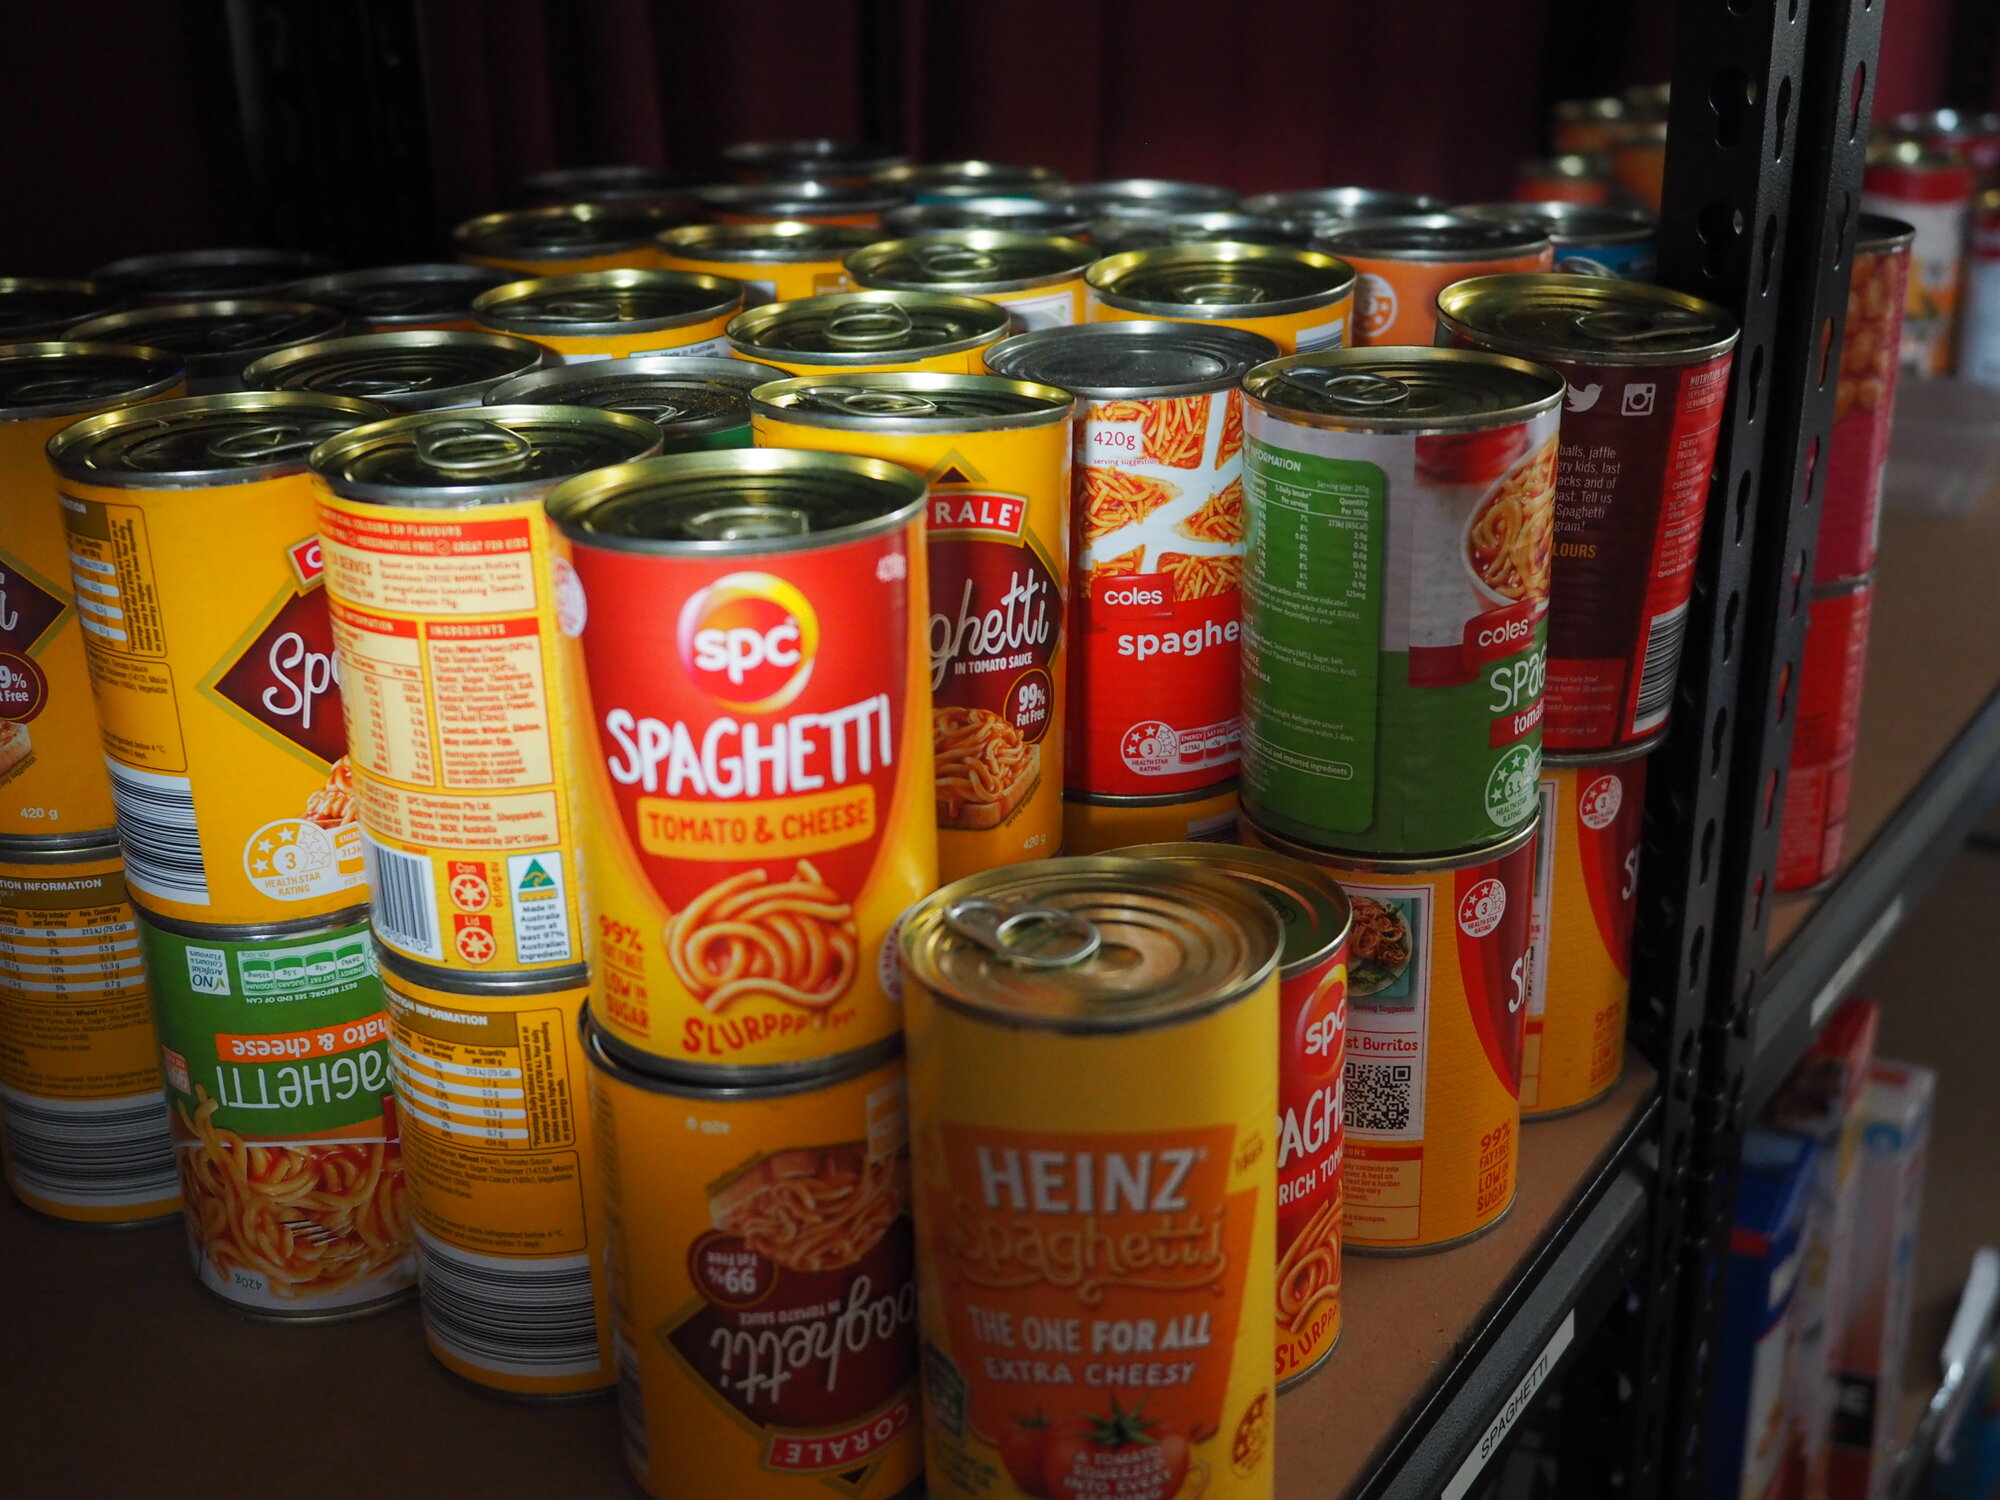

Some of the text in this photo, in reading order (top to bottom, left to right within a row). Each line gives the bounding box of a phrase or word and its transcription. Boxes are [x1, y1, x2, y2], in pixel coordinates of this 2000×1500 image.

[1093, 431, 1136, 450] 420g
[1589, 447, 1616, 460] jaffle
[1575, 461, 1598, 474] kids,
[1602, 463, 1621, 474] last
[1584, 477, 1603, 488] and
[1606, 477, 1617, 488] of
[1581, 490, 1597, 503] Tell
[1600, 494, 1612, 503] us
[1556, 504, 1605, 520] Spaghetti
[1104, 586, 1163, 605] coles
[429, 623, 506, 637] INGREDIENTS
[1478, 618, 1529, 647] coles
[1117, 619, 1241, 661] spaghe
[693, 626, 801, 686] spc
[955, 652, 1033, 675] IN TOMATO SAUCE
[1018, 683, 1046, 712] 99%
[1016, 708, 1046, 728] Fat Free
[606, 693, 893, 799] SPAGHETTI
[1146, 743, 1154, 755] 3
[1132, 758, 1169, 767] HEALTH STAR
[1139, 764, 1162, 773] RATING
[20, 807, 59, 821] 420 g
[647, 798, 869, 845] TOMATO & CHEESE
[284, 851, 298, 870] 3
[456, 862, 477, 874] Can
[24, 879, 103, 891] INFORMATION
[264, 872, 322, 889] HEALTH STAR
[278, 884, 311, 897] RATING
[522, 903, 556, 913] Made in
[1481, 902, 1488, 915] 3
[464, 916, 480, 927] Lid
[520, 913, 560, 923] Australia
[1467, 914, 1498, 930] HEALTH STAR
[525, 922, 557, 932] from at
[1474, 924, 1492, 935] RATING
[520, 933, 541, 941] least
[521, 941, 565, 950] Australian
[189, 950, 222, 961] Flavours
[519, 949, 568, 961] ingredients
[192, 965, 224, 976] Artificial
[195, 958, 223, 969] Colours
[192, 974, 213, 988] NO
[278, 979, 305, 988] SUGARS
[323, 973, 336, 982] SAT
[308, 985, 339, 998] BEFORE:
[341, 981, 358, 991] BEST
[246, 997, 263, 1005] CAN
[277, 995, 293, 1003] END
[294, 993, 308, 1001] SEE
[414, 1003, 489, 1026] INFORMATION
[232, 1037, 311, 1058] cheese
[317, 1033, 335, 1051] &
[1363, 1036, 1418, 1052] Burritos
[1481, 1119, 1511, 1154] 99%
[1479, 1143, 1510, 1168] FAT FREE
[975, 1146, 1200, 1214] HEINZ
[1479, 1170, 1500, 1194] LOW
[1278, 1168, 1316, 1207] RICH
[1477, 1180, 1508, 1212] SUGAR
[707, 1251, 758, 1265] Fat Free
[945, 1203, 1228, 1308] Spaghetti
[234, 1273, 263, 1291] 420g
[708, 1266, 757, 1294] 99%
[739, 1311, 776, 1325] SAUCE
[780, 1306, 828, 1324] TOMATO
[967, 1304, 1212, 1355] THE ONE FOR ALL
[984, 1358, 1196, 1388] EXTRA CHEESY
[1480, 1354, 1549, 1460] SPAGHETTI
[785, 1402, 911, 1464] CORALE
